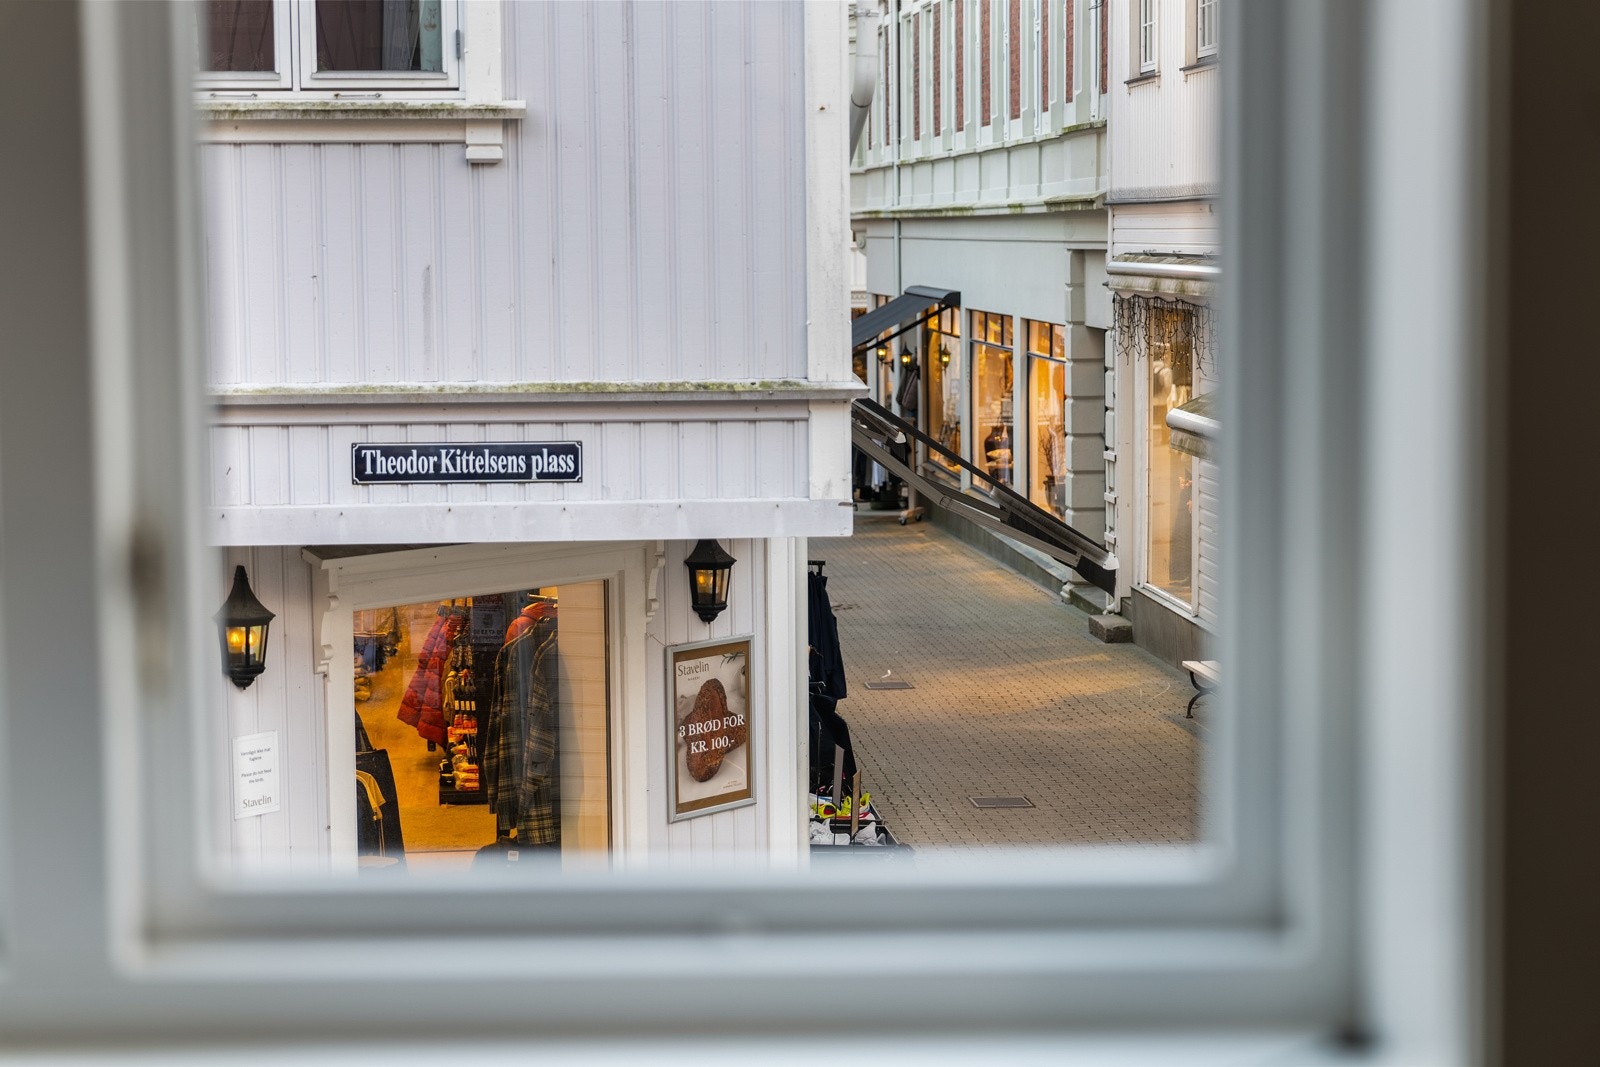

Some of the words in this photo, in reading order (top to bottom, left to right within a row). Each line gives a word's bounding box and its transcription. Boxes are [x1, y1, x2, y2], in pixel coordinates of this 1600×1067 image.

[362, 449, 437, 475] Theodor
[439, 448, 526, 474] Kittelsens
[531, 448, 575, 480] plass
[677, 661, 710, 676] Stavelin
[679, 725, 686, 738] 3
[688, 719, 721, 736] BRØD
[723, 714, 745, 729] FOR
[690, 740, 709, 754] KR.
[711, 736, 735, 750] 100,-
[243, 795, 272, 809] Stavelin
